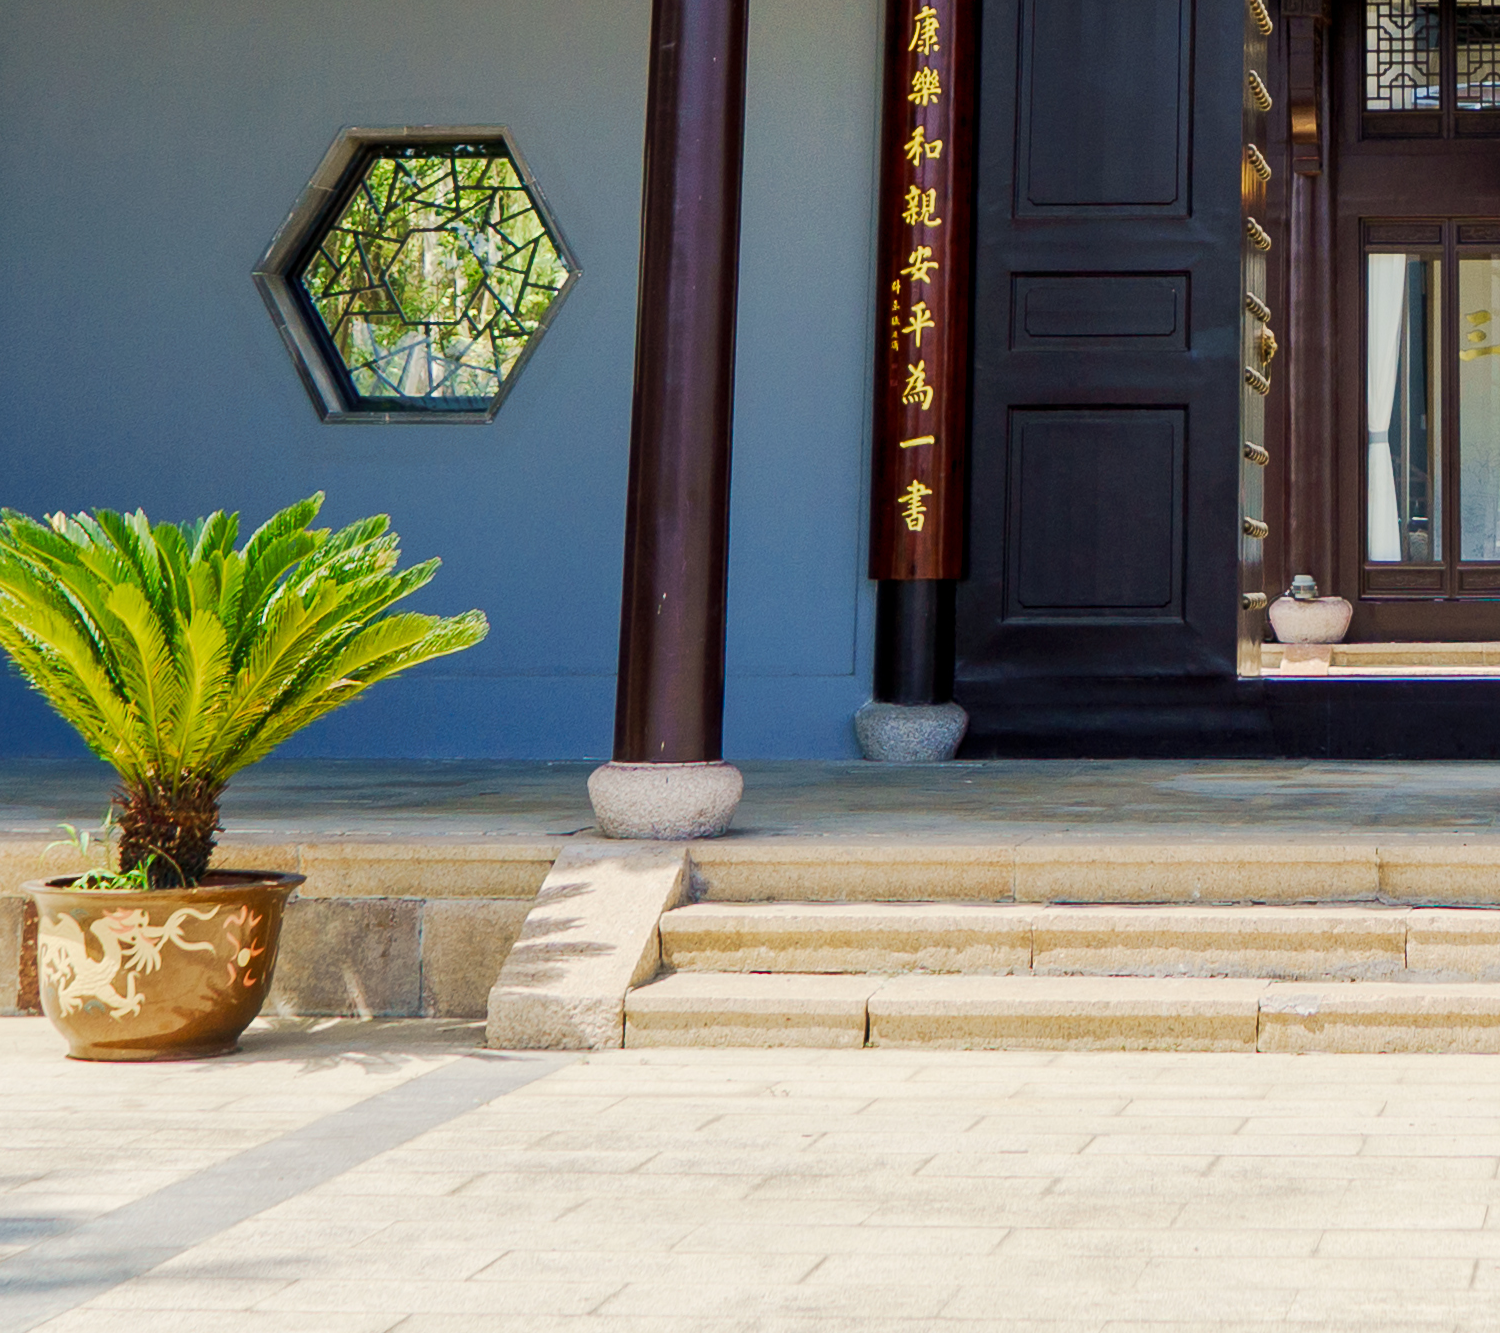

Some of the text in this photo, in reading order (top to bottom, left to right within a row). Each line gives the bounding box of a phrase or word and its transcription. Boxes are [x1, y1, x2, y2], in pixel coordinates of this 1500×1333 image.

[898, 5, 943, 532] 康樂和親安平為一書
